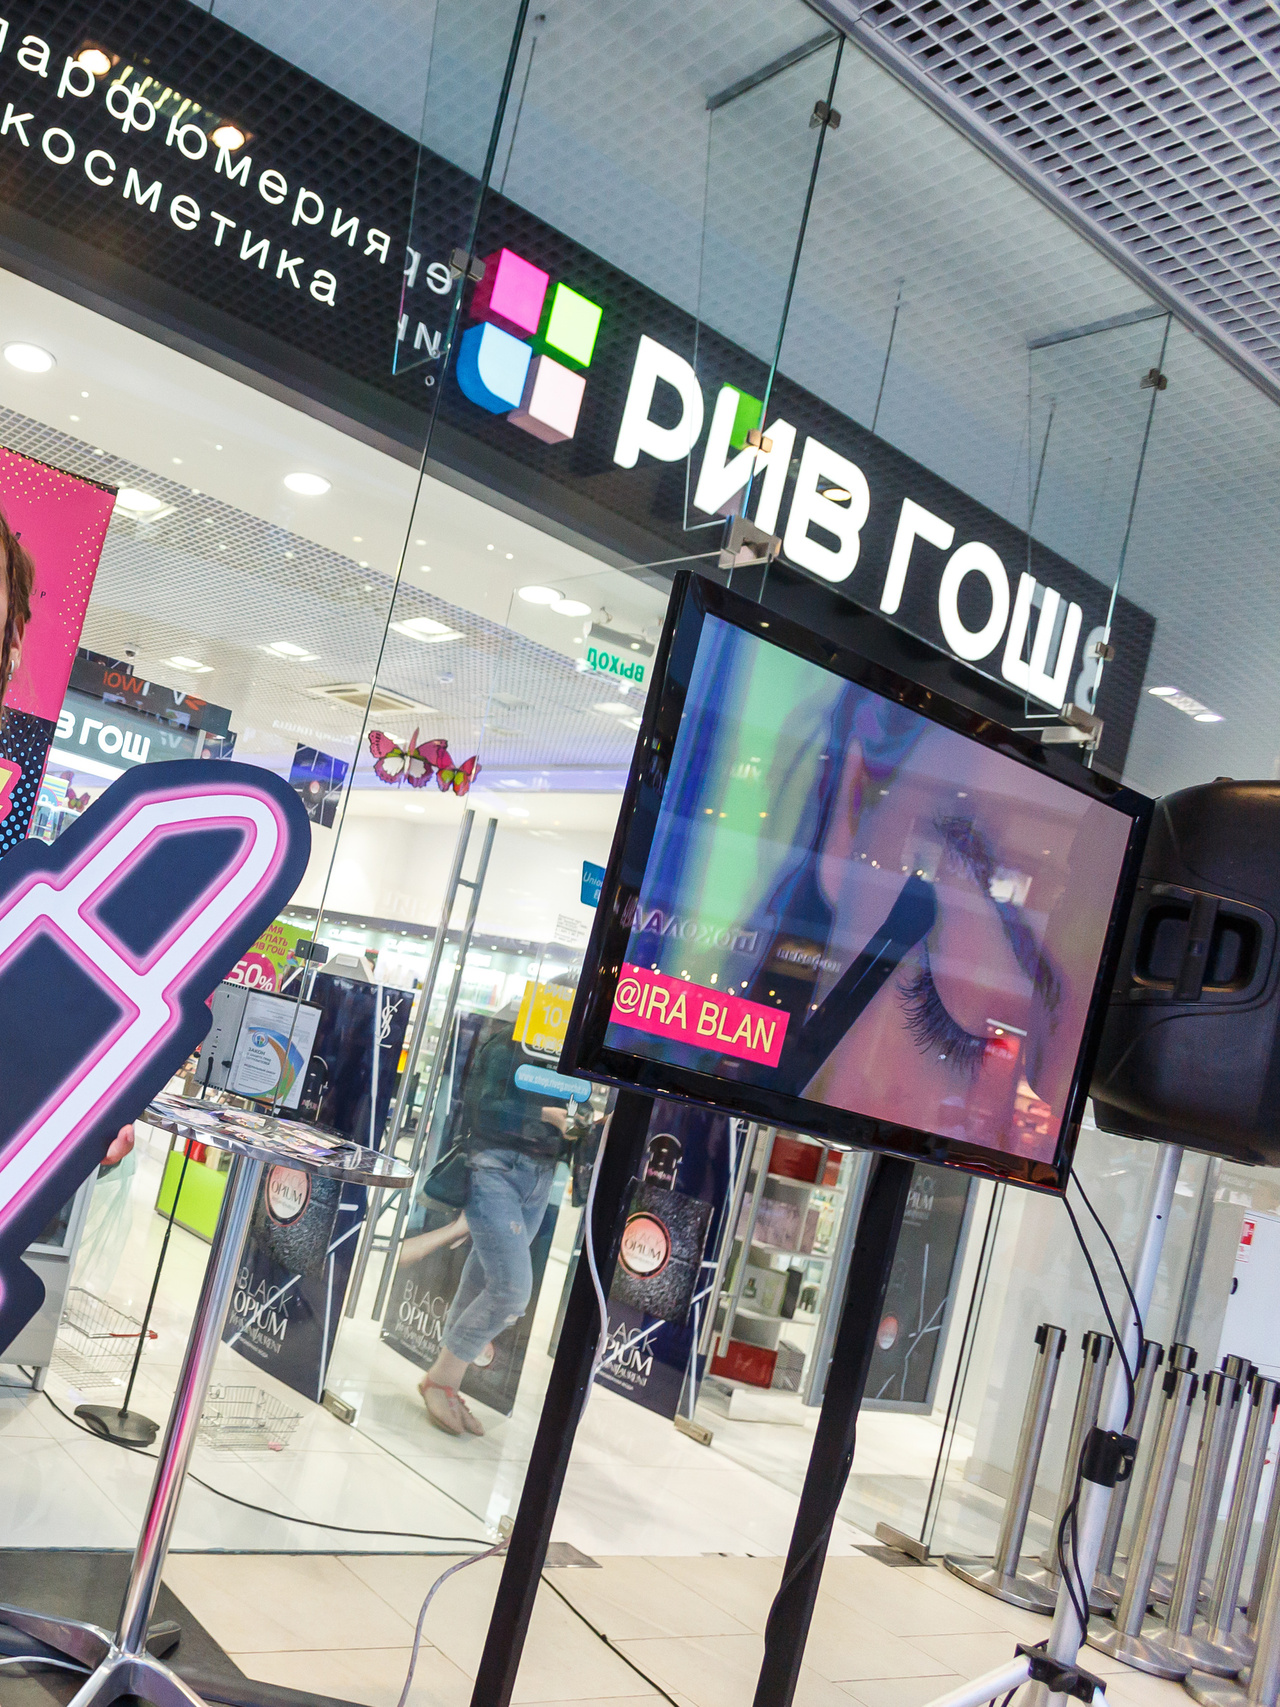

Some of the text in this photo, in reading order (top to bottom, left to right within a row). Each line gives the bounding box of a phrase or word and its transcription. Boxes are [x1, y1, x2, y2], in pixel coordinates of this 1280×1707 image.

[0, 102, 336, 306] косметика
[613, 334, 1083, 710] РИВ ГОШ
[79, 717, 151, 763] ГОШ
[266, 945, 286, 956] ГОШ
[614, 977, 777, 1054] @IRA BLAN
[233, 1290, 289, 1341] OPIUM
[237, 1267, 294, 1318] BLACK
